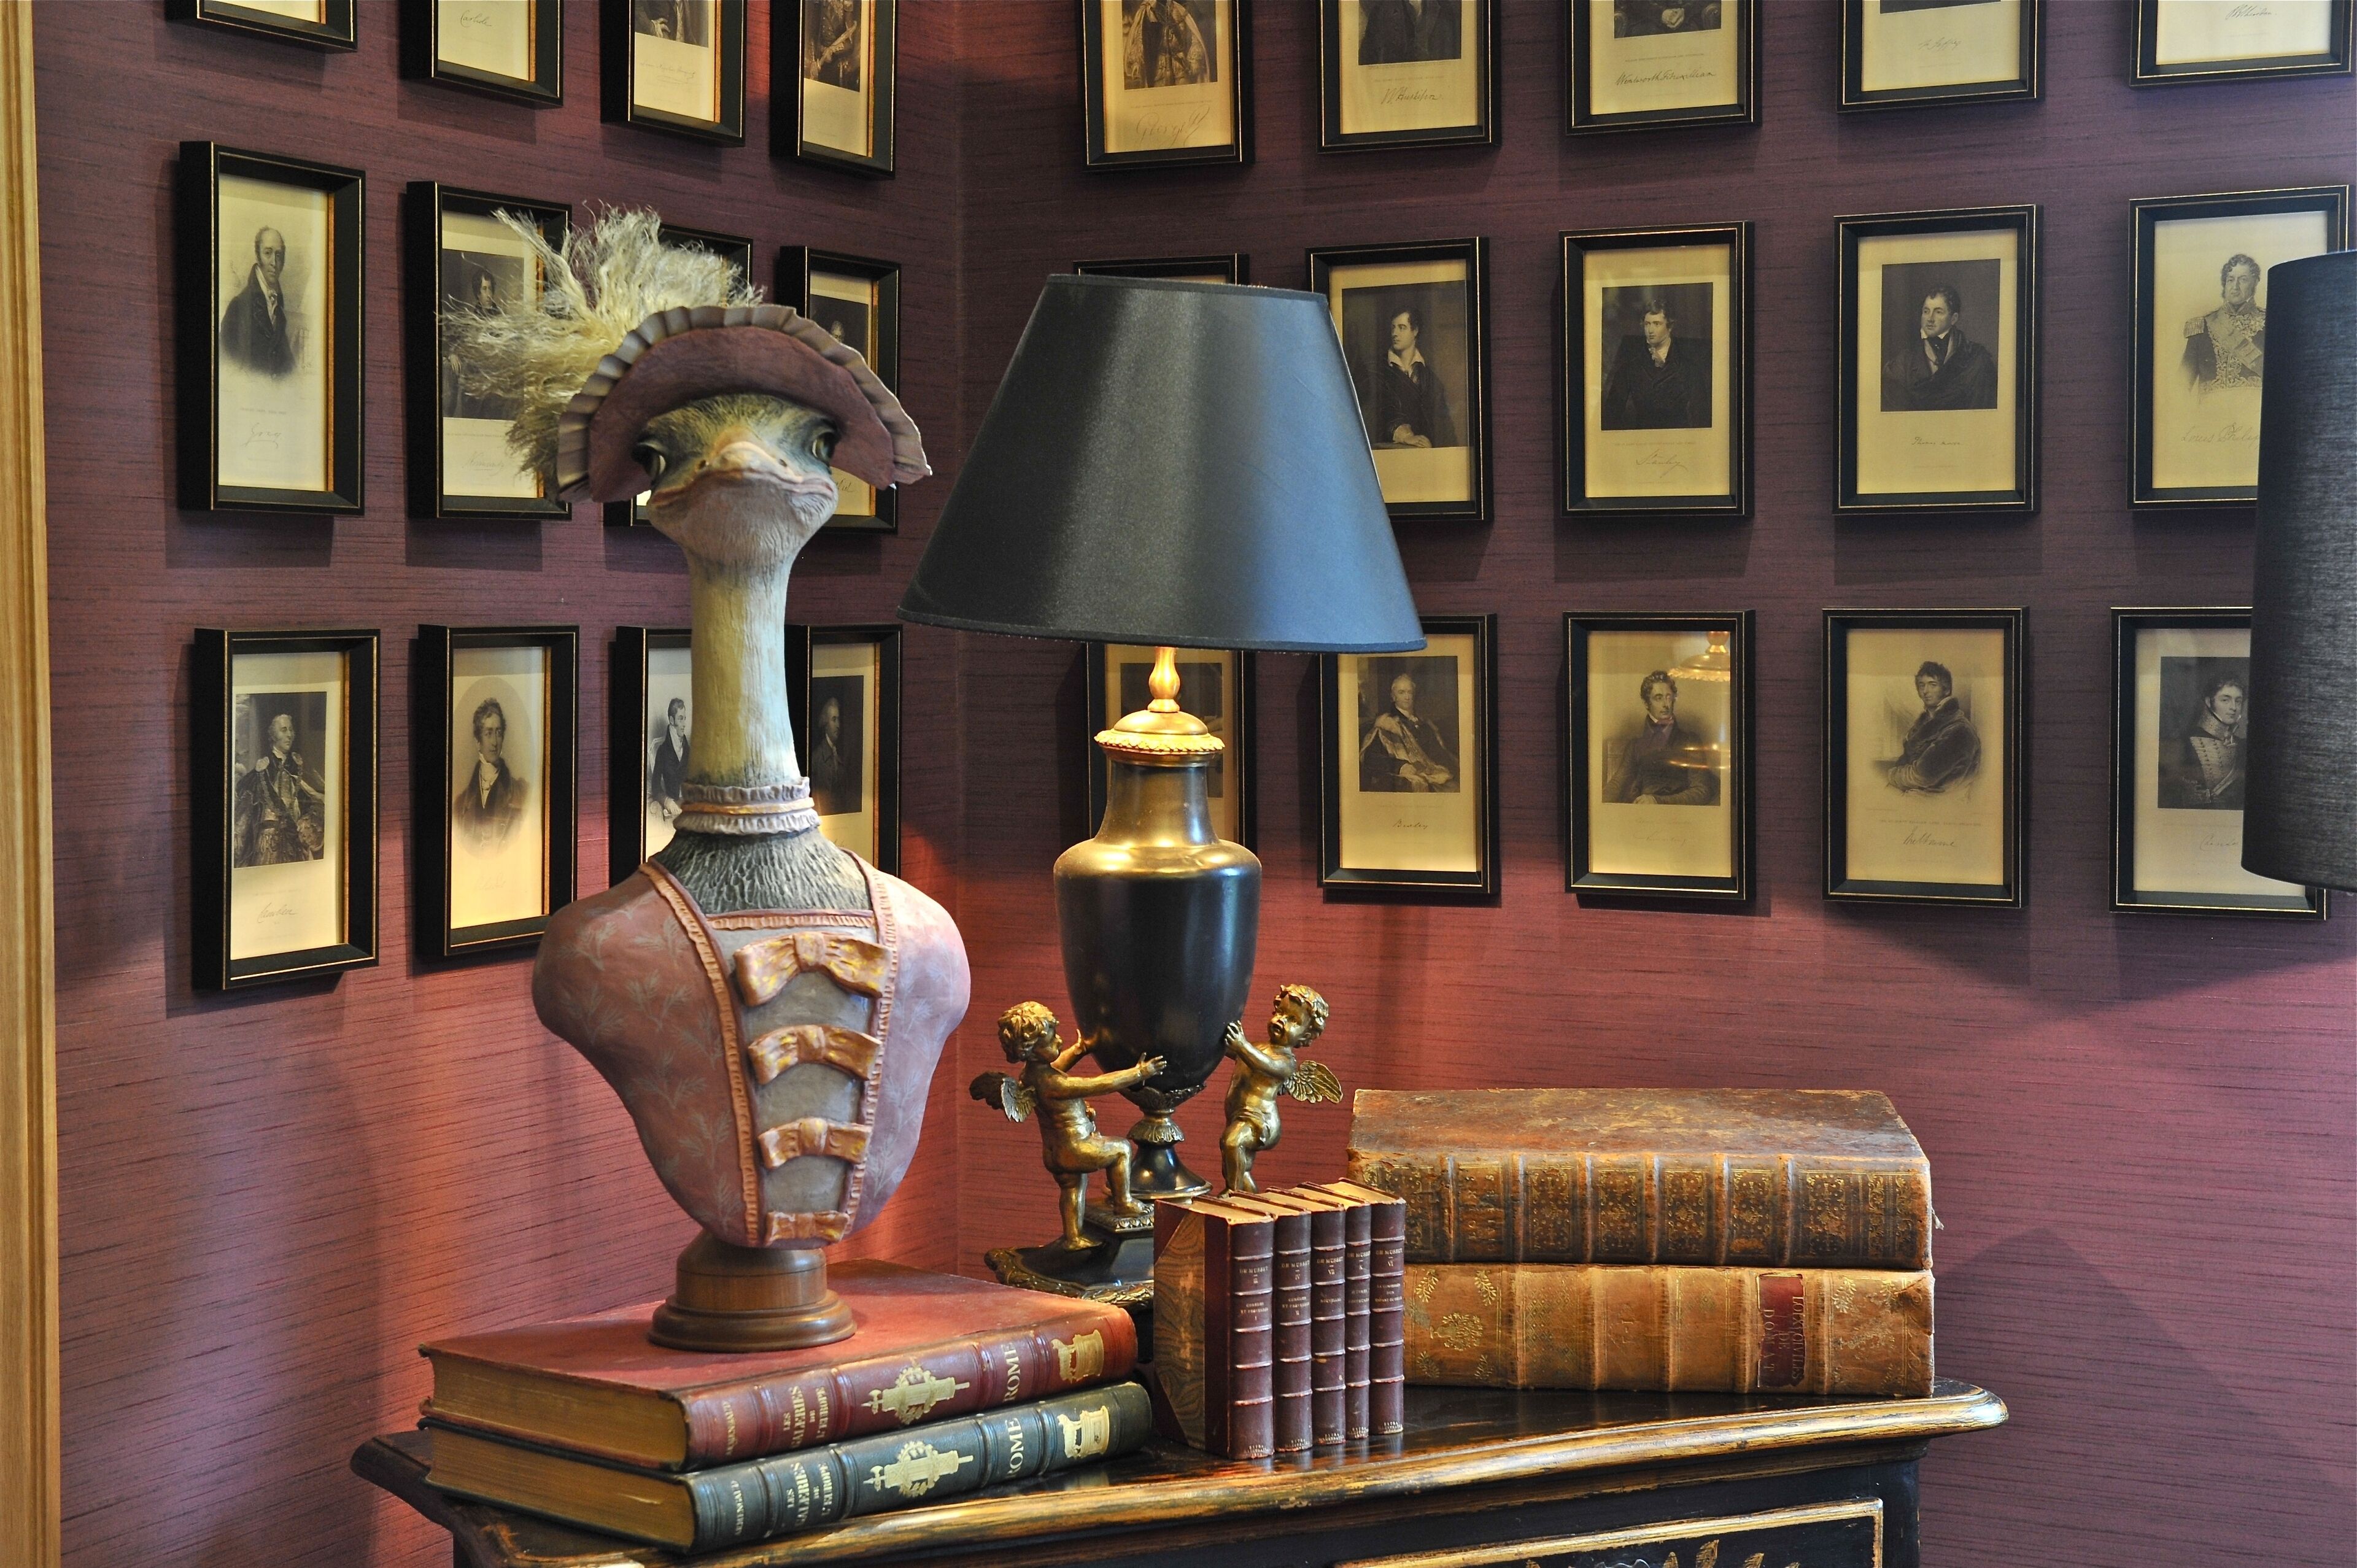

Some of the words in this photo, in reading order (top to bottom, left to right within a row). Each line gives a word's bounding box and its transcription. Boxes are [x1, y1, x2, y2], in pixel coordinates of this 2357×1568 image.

[1001, 1342, 1021, 1403] ROME
[783, 1412, 791, 1431] LES
[788, 1385, 806, 1448] GALERIES
[1004, 1417, 1024, 1479] ROME
[786, 1488, 795, 1509] LES
